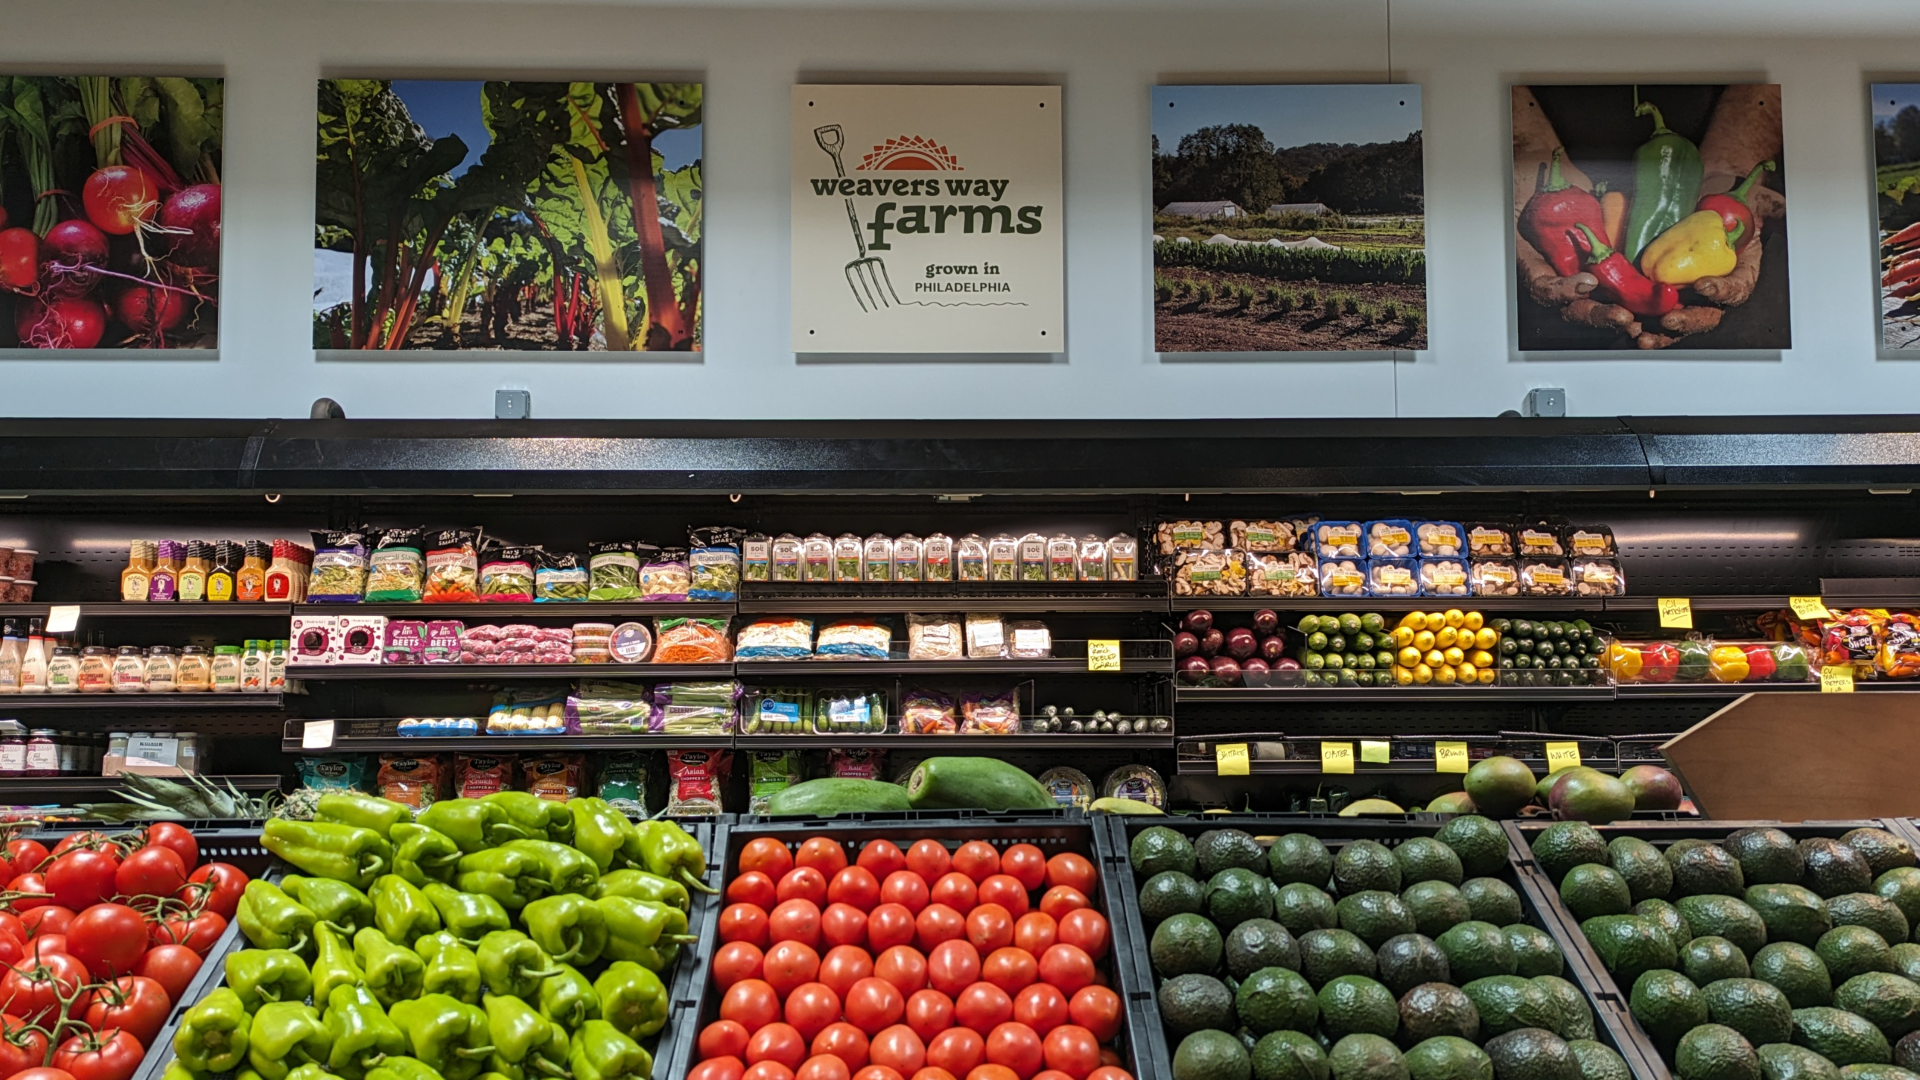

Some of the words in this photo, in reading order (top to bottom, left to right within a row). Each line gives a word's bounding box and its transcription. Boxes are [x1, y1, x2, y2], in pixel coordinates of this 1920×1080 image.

[810, 178, 940, 196] weavers
[945, 179, 1009, 201] way
[867, 202, 1043, 250] farms
[925, 263, 978, 278] grown
[983, 262, 1000, 275] in
[915, 282, 1011, 293] PHILADELPHIA
[431, 639, 457, 647] BEETS
[1848, 635, 1873, 649] Sweet
[683, 753, 707, 761] Taylor
[1550, 750, 1577, 760] WHITE
[320, 764, 343, 772] Taylor
